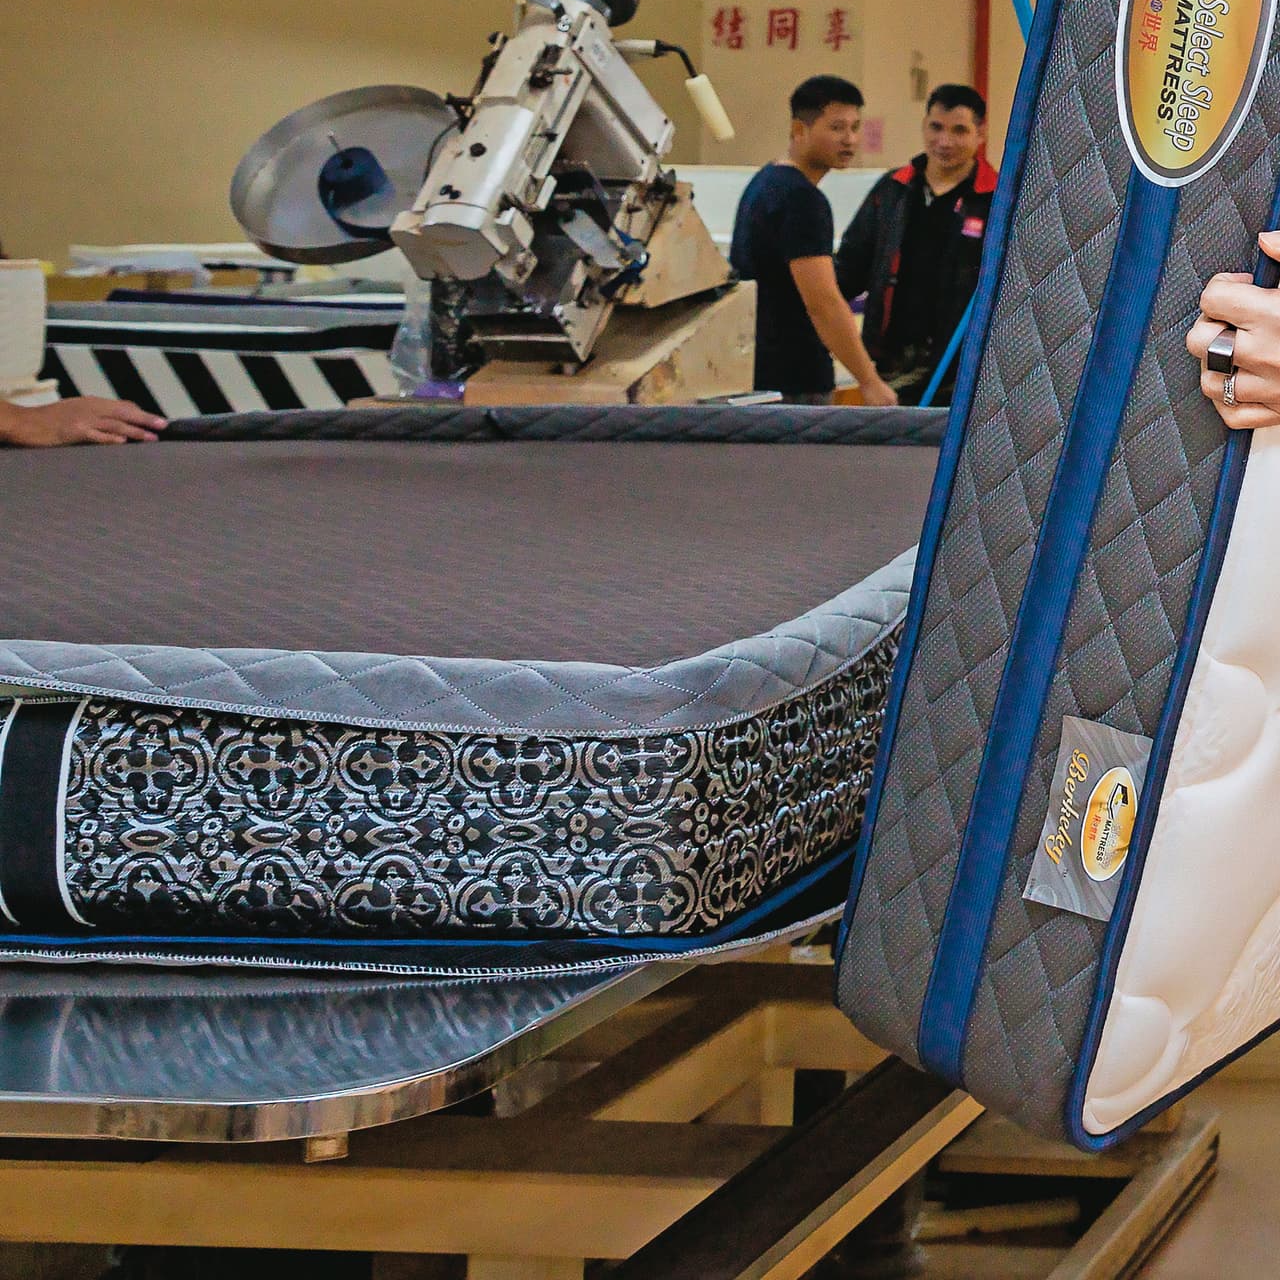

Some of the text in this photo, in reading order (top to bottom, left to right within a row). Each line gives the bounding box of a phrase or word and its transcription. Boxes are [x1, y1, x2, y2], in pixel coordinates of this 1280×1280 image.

[1163, 78, 1213, 152] Sleep
[1044, 748, 1091, 865] Berkeley
[1095, 820, 1113, 862] MATTRESS
